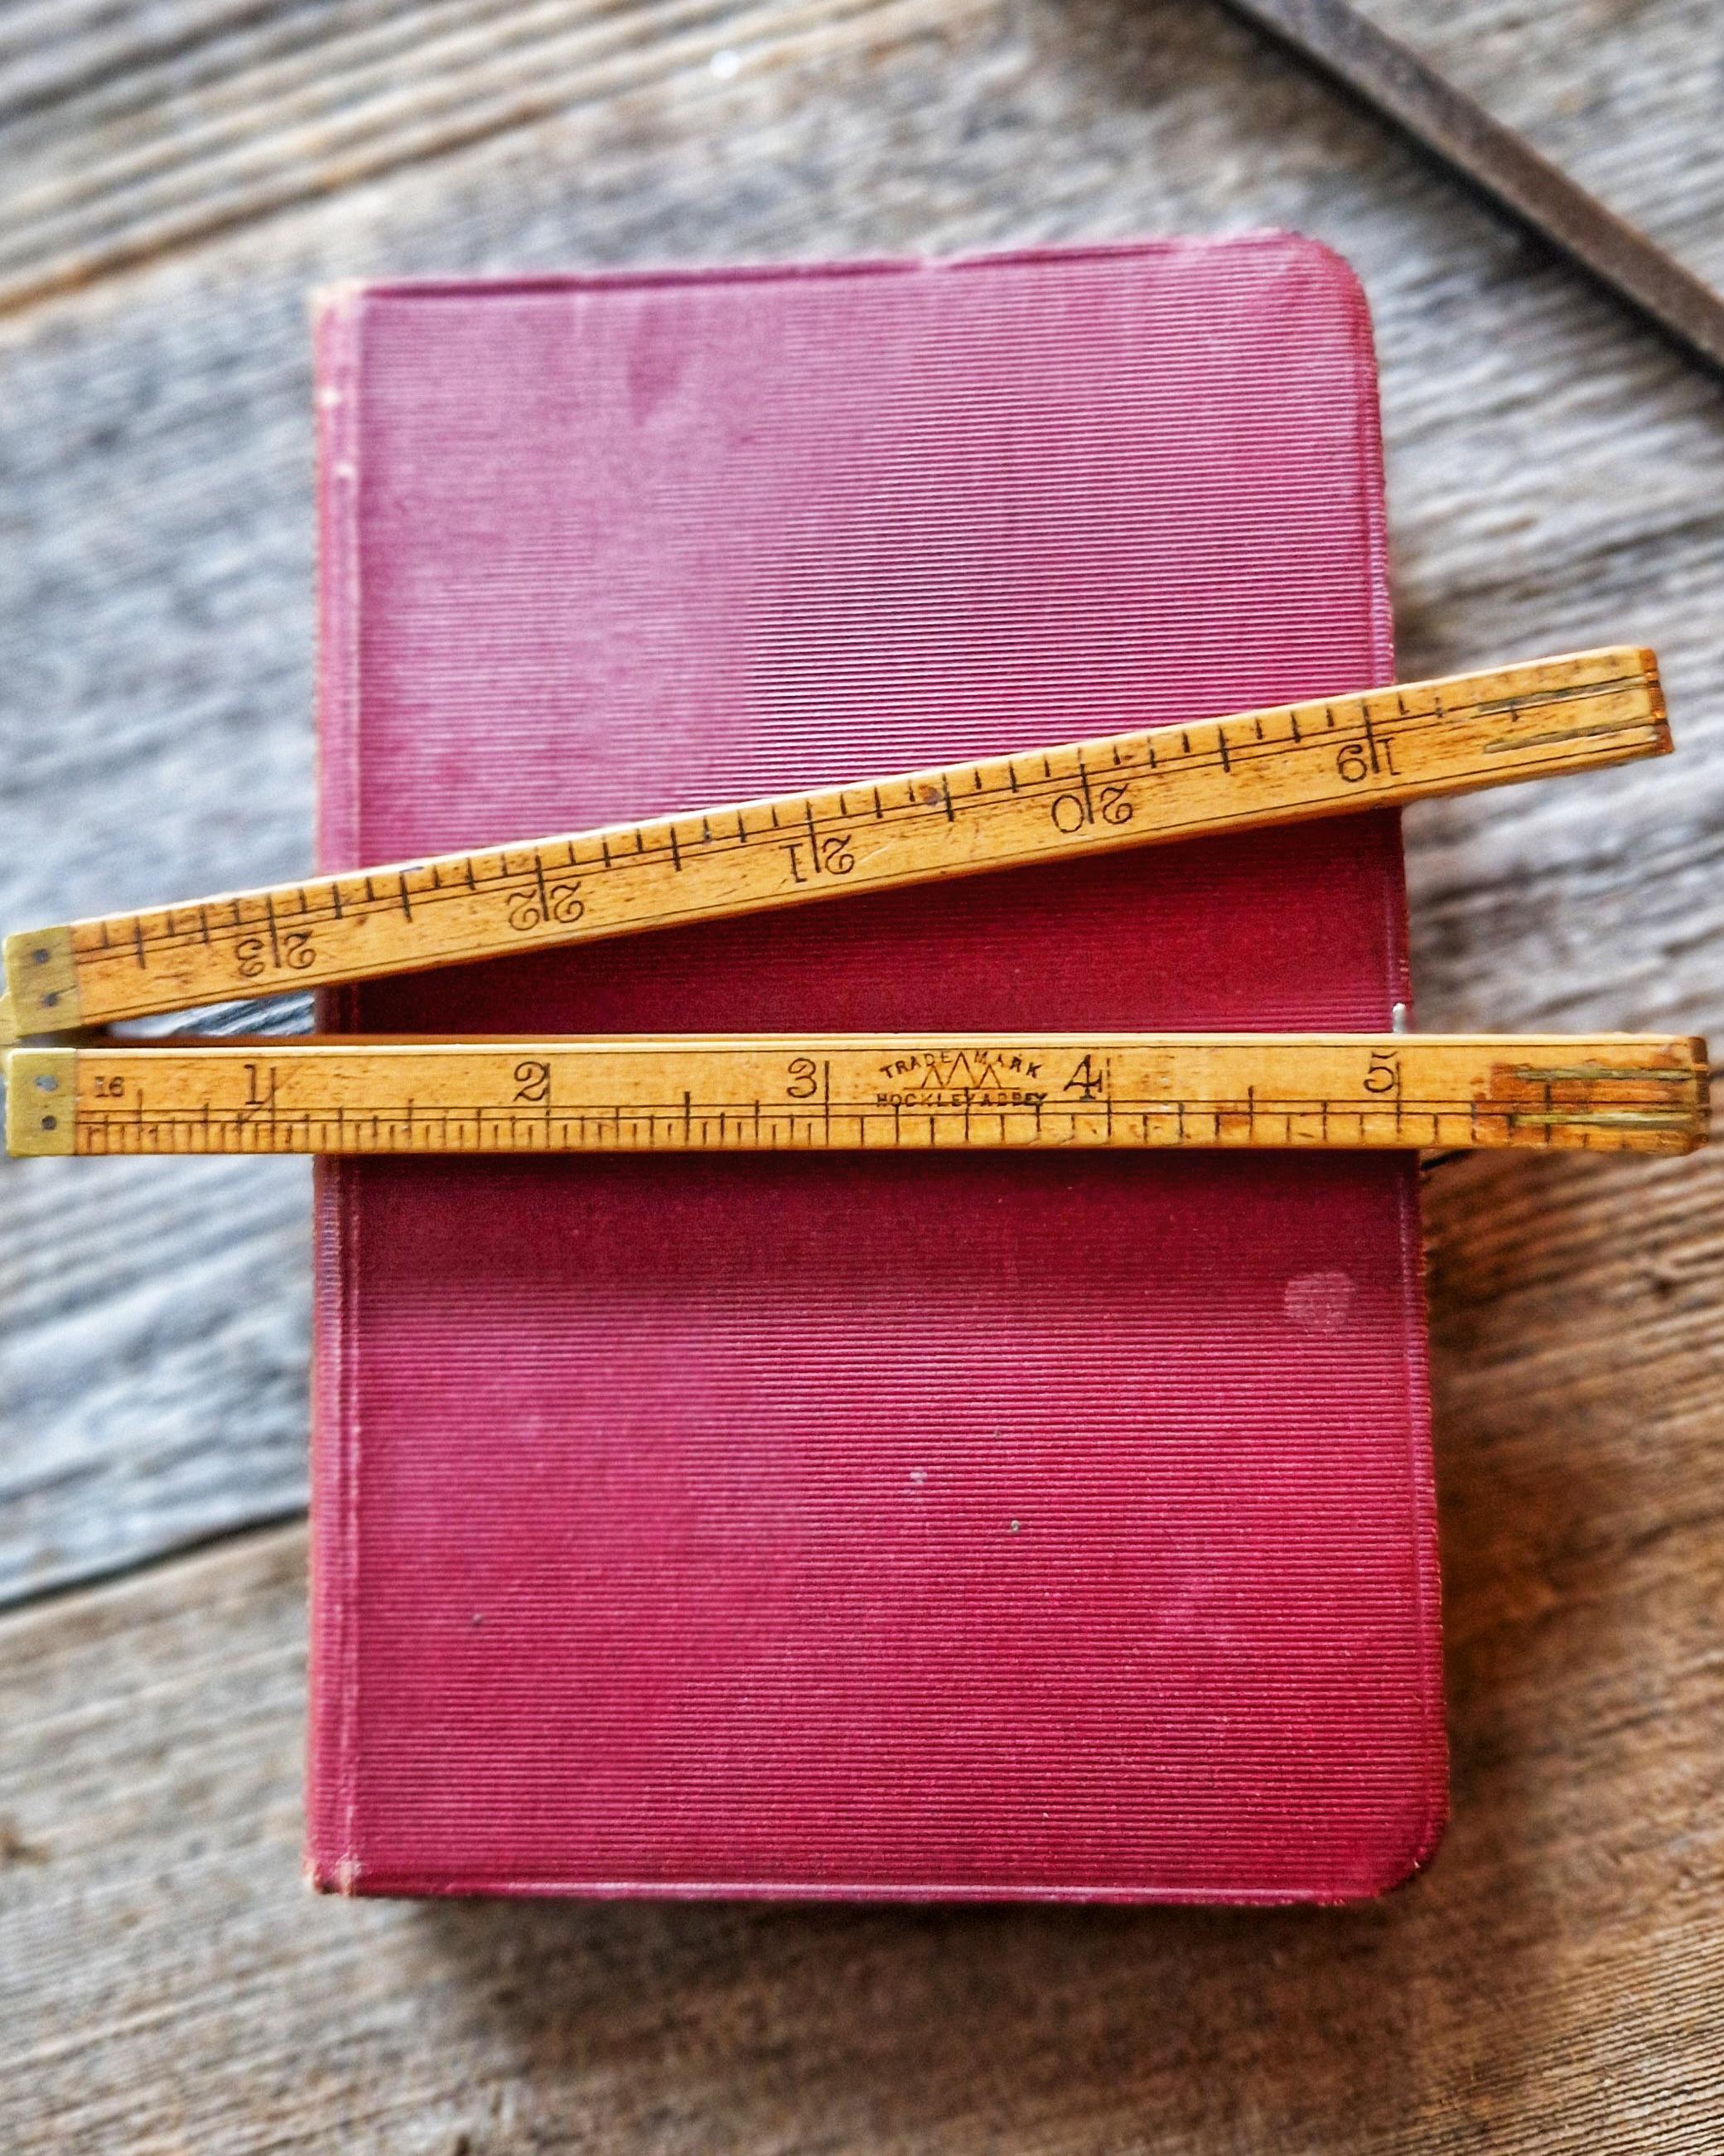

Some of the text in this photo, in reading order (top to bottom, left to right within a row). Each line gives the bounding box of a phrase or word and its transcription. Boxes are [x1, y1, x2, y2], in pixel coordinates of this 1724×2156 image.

[1336, 737, 1400, 783] 19
[1051, 783, 1133, 834] 20
[780, 834, 855, 883] 21
[505, 882, 586, 931] 22
[234, 929, 316, 978] 23
[244, 1064, 266, 1105] 1
[513, 1061, 548, 1103] 2
[786, 1057, 817, 1098] 3
[878, 1049, 1042, 1079] TRADE MARK
[1063, 1054, 1103, 1101] 4
[1364, 1051, 1398, 1093] 5
[94, 1076, 125, 1098] 16
[876, 1092, 976, 1107] HOCKLEY
